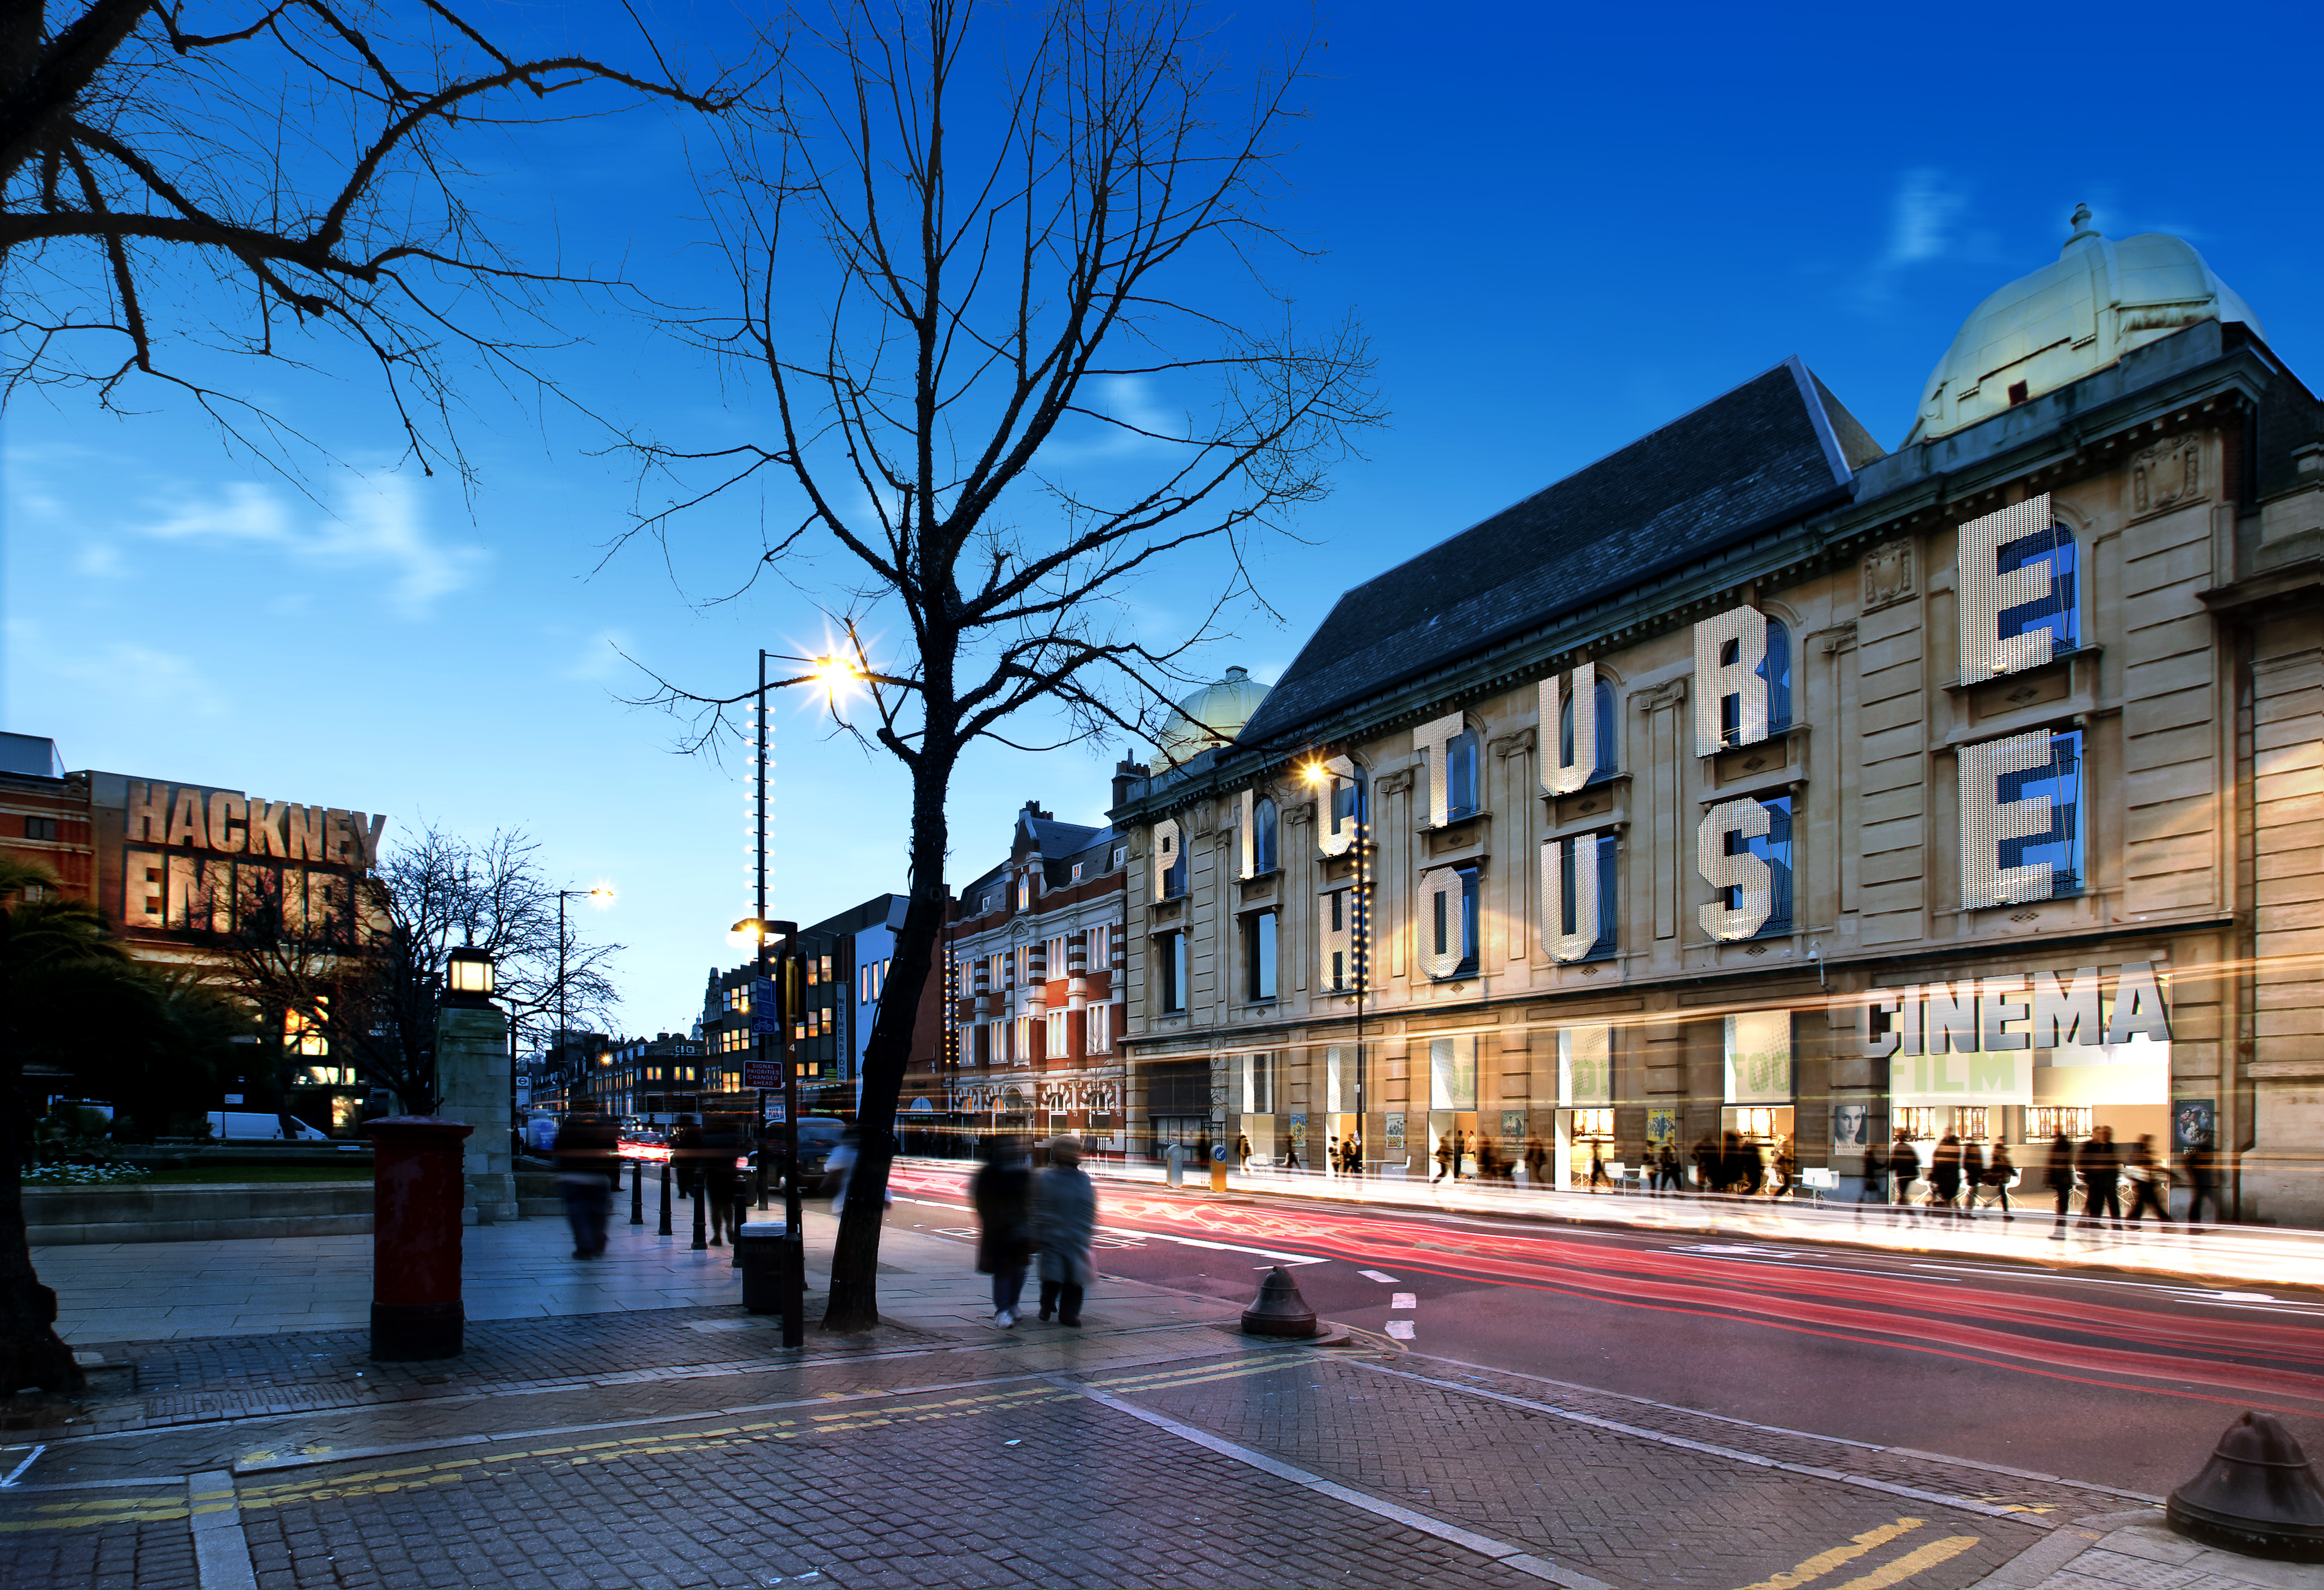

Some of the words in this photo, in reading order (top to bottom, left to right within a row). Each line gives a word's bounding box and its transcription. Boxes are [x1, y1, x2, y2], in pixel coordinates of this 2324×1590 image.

[1154, 492, 2052, 904] PICTURE
[127, 781, 387, 869] HACKNEY
[1319, 729, 2053, 993] HOUSE
[789, 1044, 796, 1052] 4
[837, 997, 845, 1081] WETHERSPOON
[1855, 961, 2172, 1058] CINEMA
